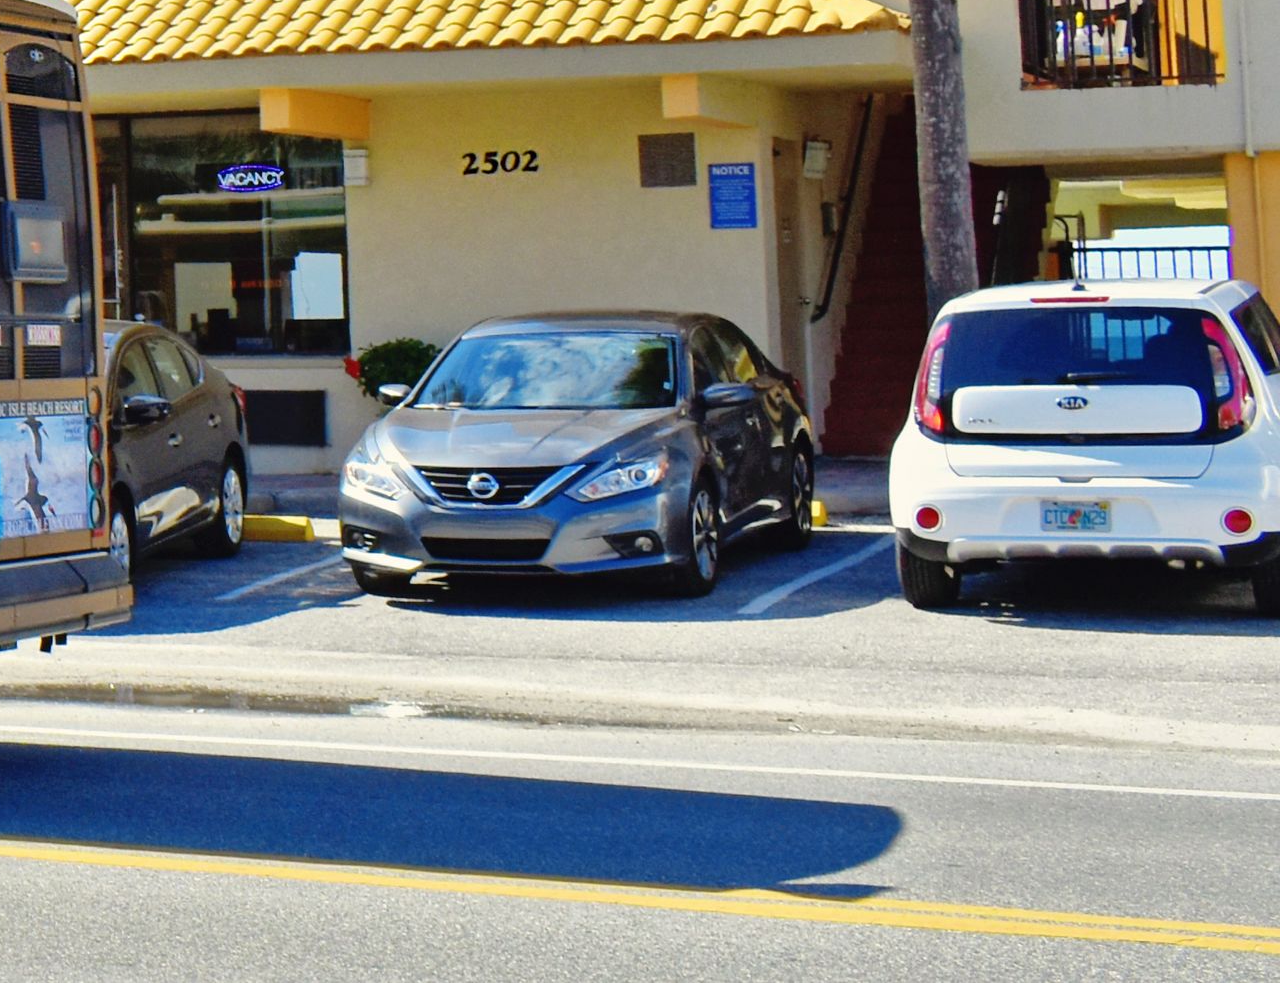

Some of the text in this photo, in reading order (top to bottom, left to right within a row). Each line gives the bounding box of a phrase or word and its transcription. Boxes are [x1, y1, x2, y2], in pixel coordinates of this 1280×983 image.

[462, 150, 539, 175] 2502
[712, 166, 749, 175] NOTICE
[217, 170, 284, 186] VACANCY
[8, 402, 26, 416] ISLE
[26, 401, 53, 415] BEACH
[54, 400, 85, 414] RESORT
[1061, 397, 1086, 409] KIA
